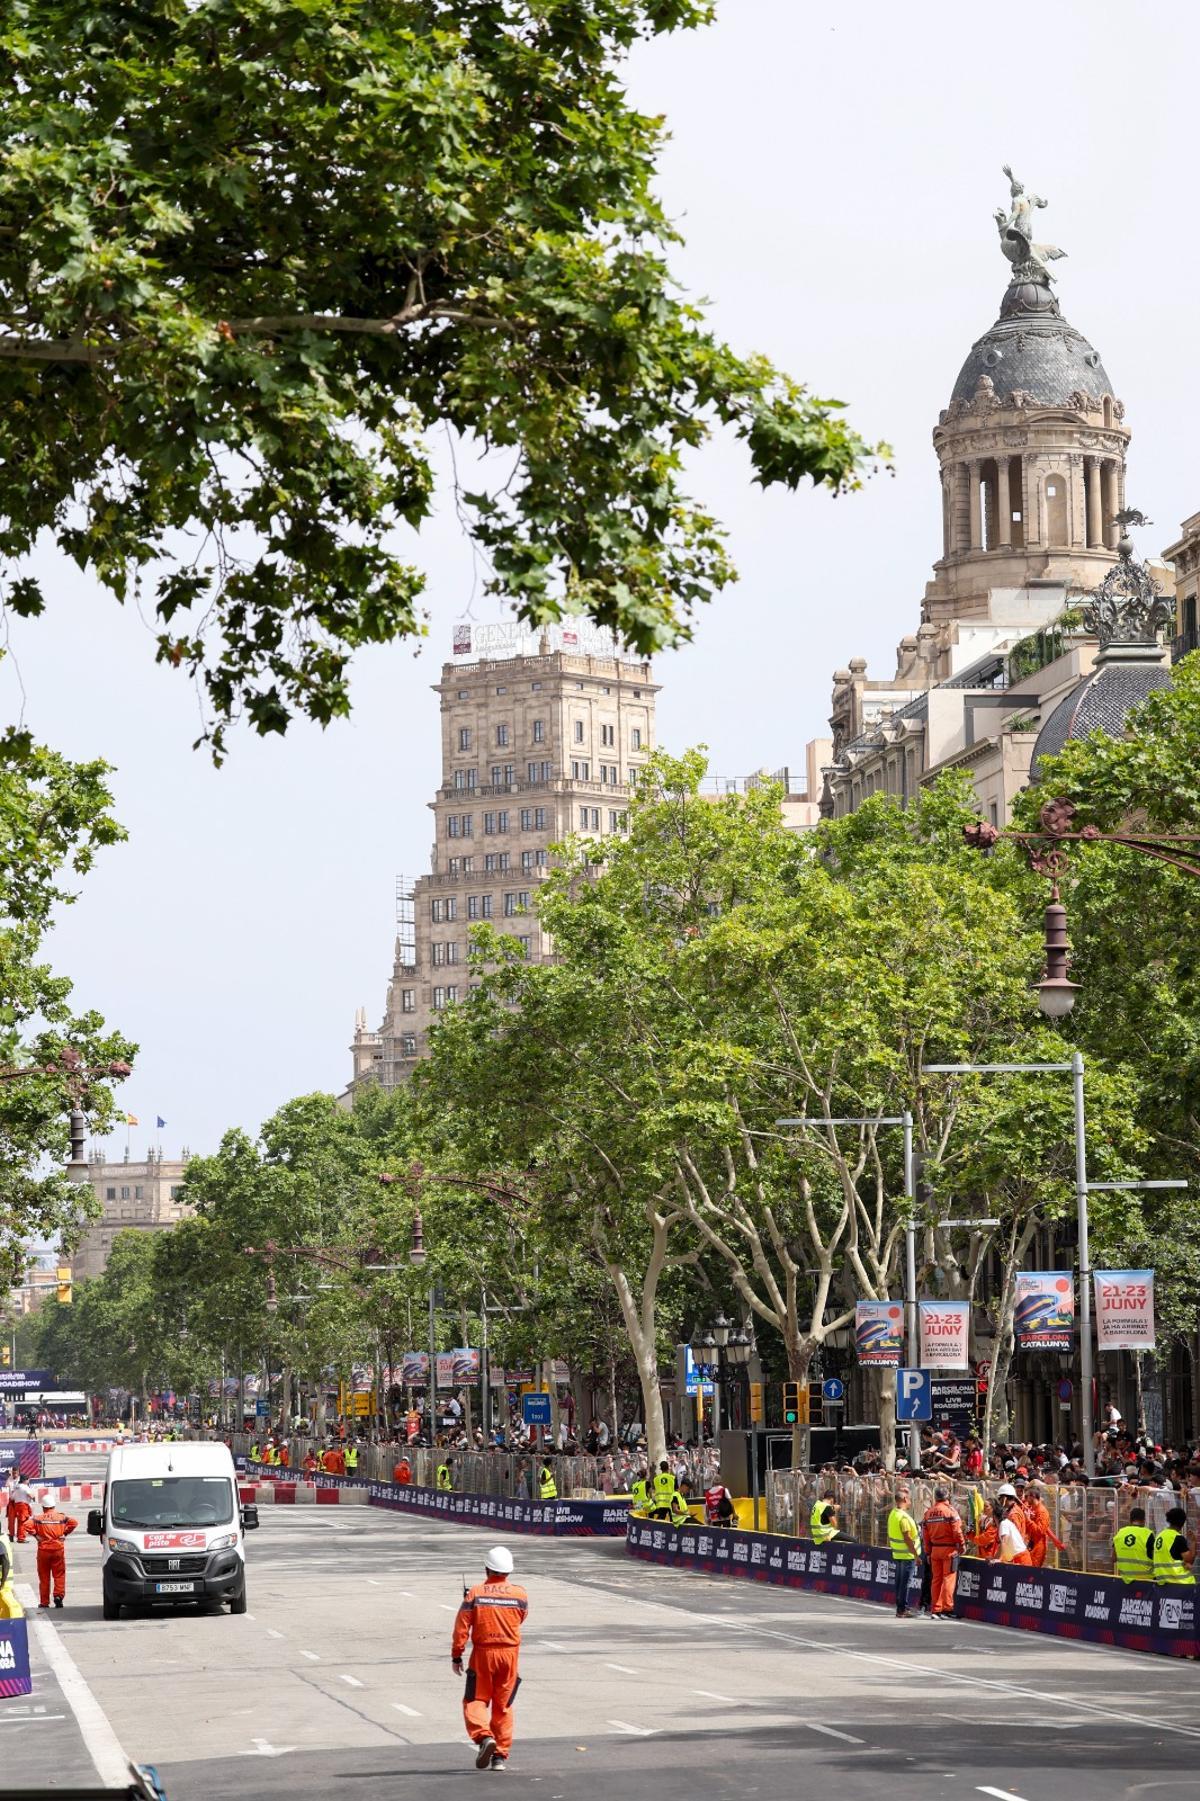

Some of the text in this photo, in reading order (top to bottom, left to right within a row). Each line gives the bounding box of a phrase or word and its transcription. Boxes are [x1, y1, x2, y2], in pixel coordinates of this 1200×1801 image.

[1102, 1285, 1147, 1297] 21-23
[1102, 1298, 1147, 1310] JUNY
[925, 1314, 962, 1324] 21-23
[925, 1325, 962, 1336] JUNY
[903, 1371, 924, 1398] P
[168, 1560, 180, 1570] FIAT
[484, 1585, 511, 1594] RACC
